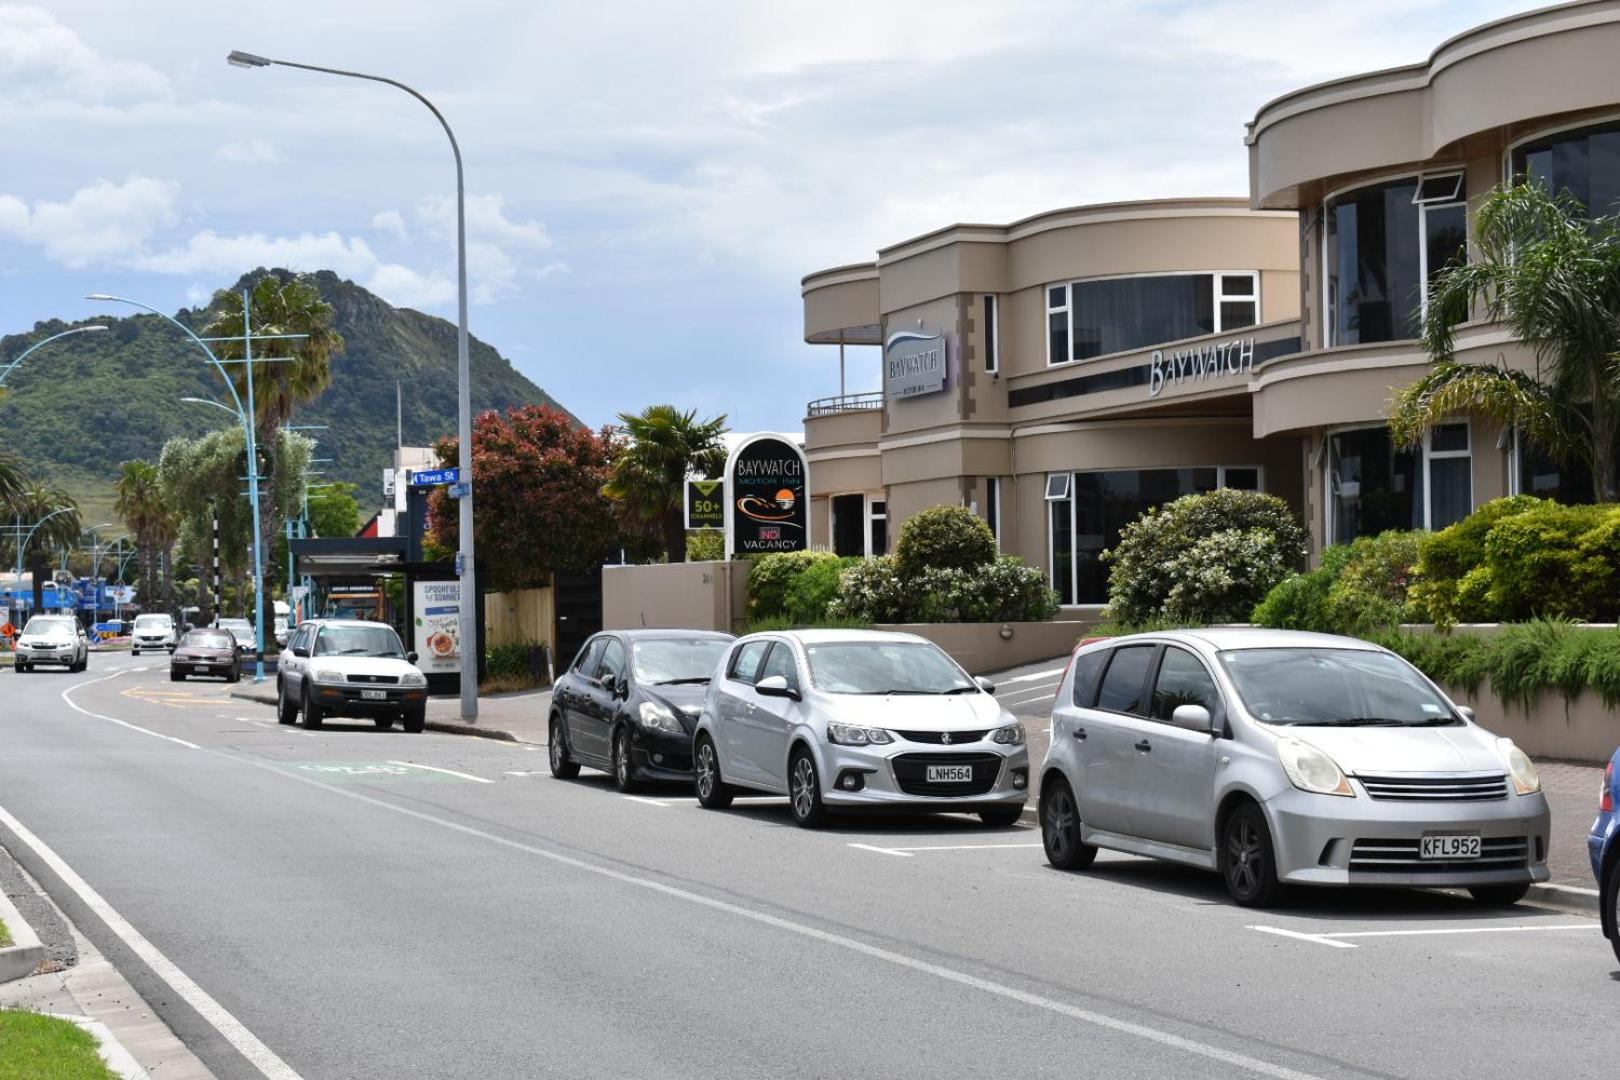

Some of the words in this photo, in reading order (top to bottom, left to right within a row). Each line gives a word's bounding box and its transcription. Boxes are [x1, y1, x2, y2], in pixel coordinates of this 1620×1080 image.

[889, 349, 938, 379] BAYWATCH
[1149, 336, 1255, 398] BAYWATCH
[738, 459, 800, 476] BAYWATCH
[419, 473, 442, 483] Tawa
[444, 471, 455, 481] St
[695, 500, 720, 513] 50+
[761, 529, 778, 539] NO
[743, 540, 797, 550] VACANCY
[928, 768, 971, 780] LNH564
[1423, 838, 1479, 855] KFL952
